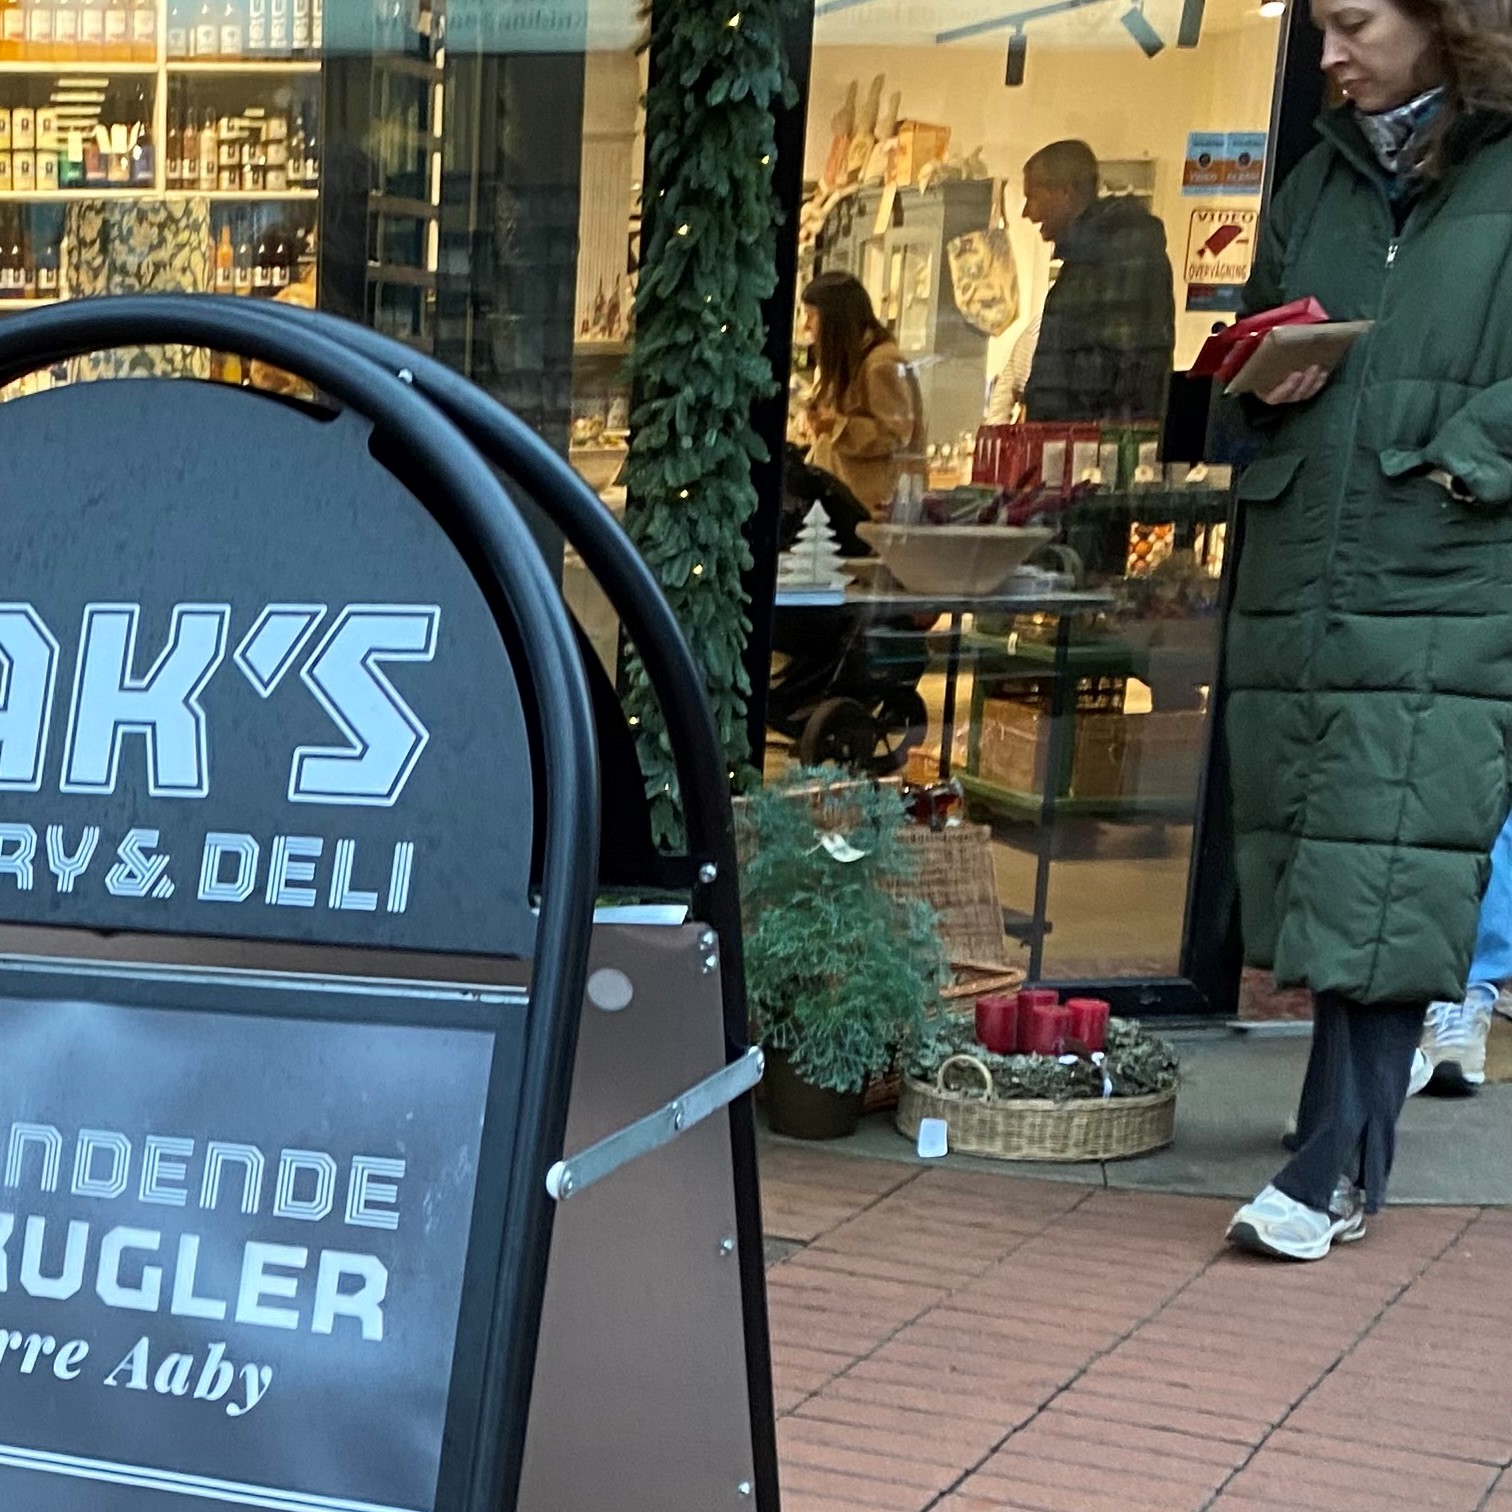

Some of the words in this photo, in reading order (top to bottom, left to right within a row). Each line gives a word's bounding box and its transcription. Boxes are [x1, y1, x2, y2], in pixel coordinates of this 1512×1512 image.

[1197, 212, 1255, 222] VIDEO
[105, 829, 174, 898] &
[198, 833, 414, 912] DELI
[104, 1337, 272, 1416] Aaby
